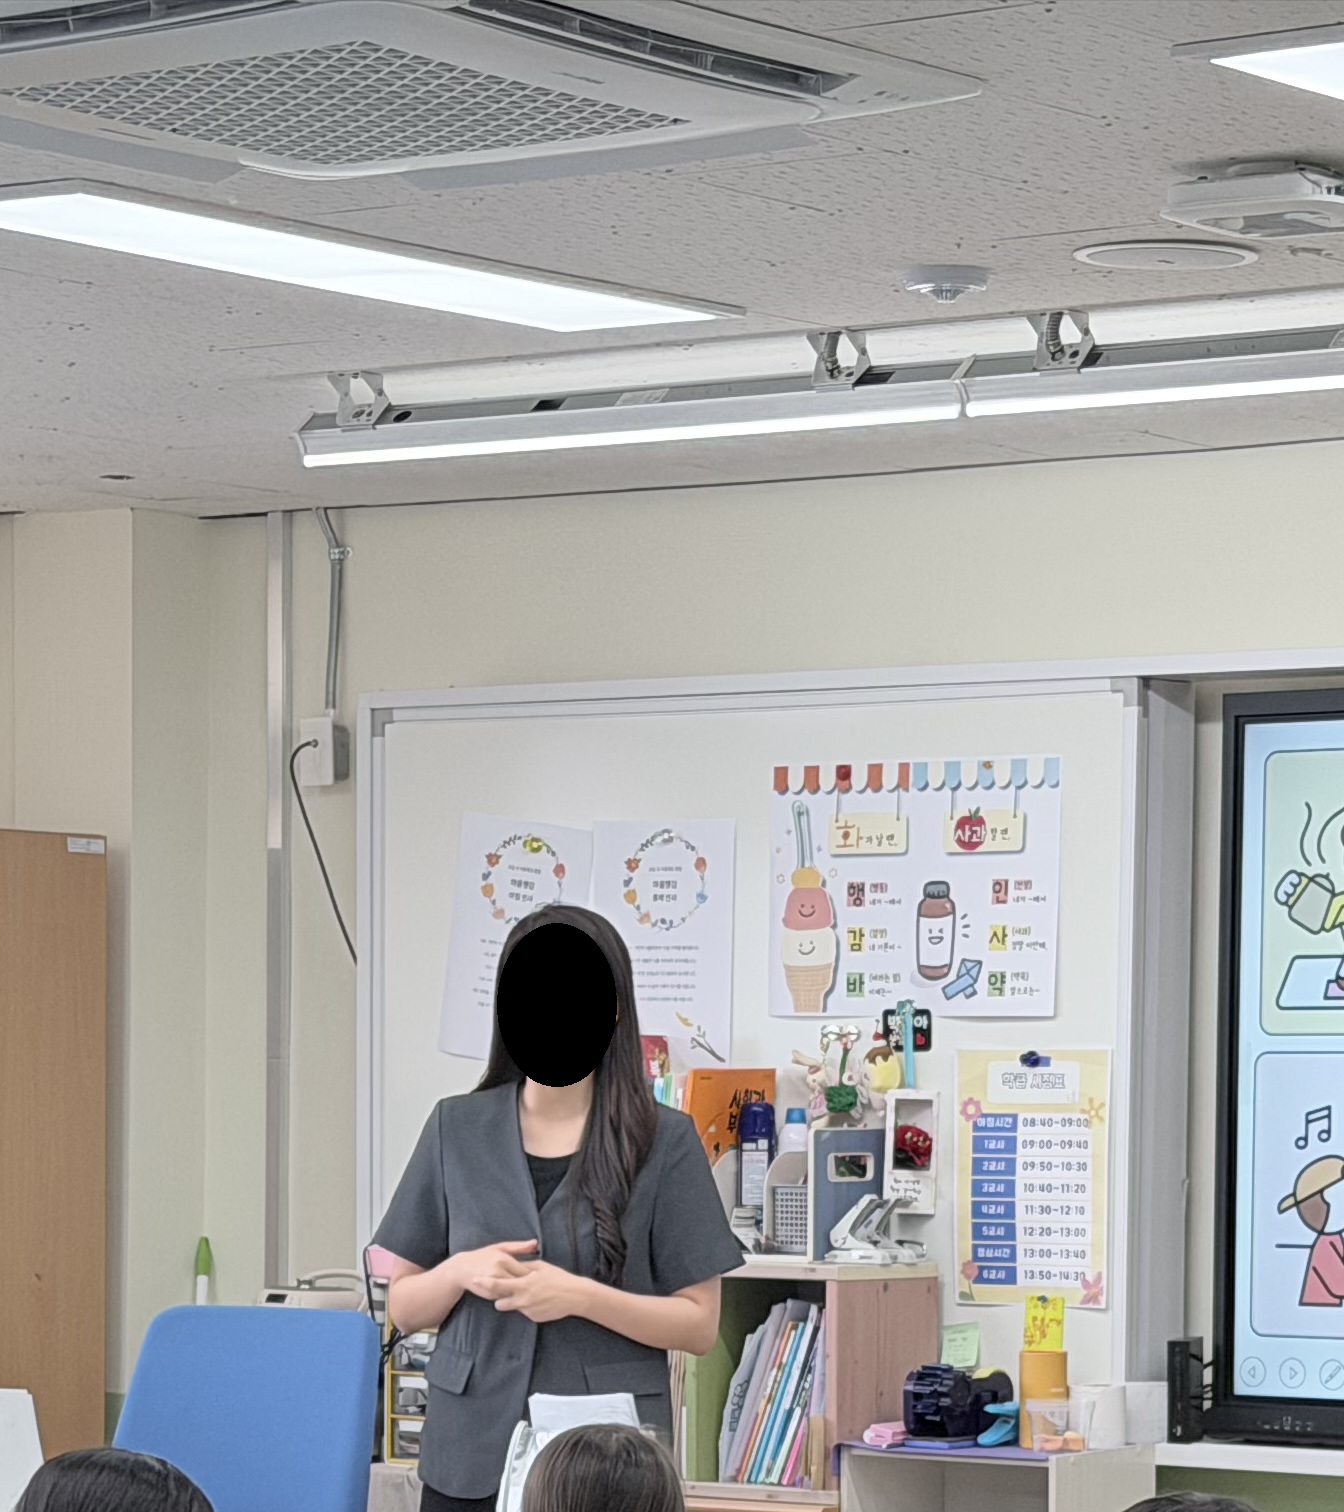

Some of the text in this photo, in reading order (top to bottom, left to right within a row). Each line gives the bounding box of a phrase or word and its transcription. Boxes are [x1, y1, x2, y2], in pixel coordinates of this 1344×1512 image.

[847, 881, 865, 907] 행
[992, 880, 1009, 904] 인
[847, 927, 865, 952] 감
[989, 925, 1008, 946] 사
[847, 973, 865, 993] 바
[987, 972, 1006, 996] 약
[1022, 1117, 1089, 1128] 08:40-09:00
[1022, 1139, 1088, 1150] 09:00-09:40
[1022, 1161, 1087, 1172] 09:50-10:30
[1023, 1183, 1086, 1194] 10:40-11:20
[1024, 1205, 1085, 1216] 11:30-12:10
[1023, 1226, 1086, 1238] 12:20-13:00
[1023, 1248, 1086, 1260] 13:00-13:40
[1024, 1269, 1086, 1281] 13:50-14:30
